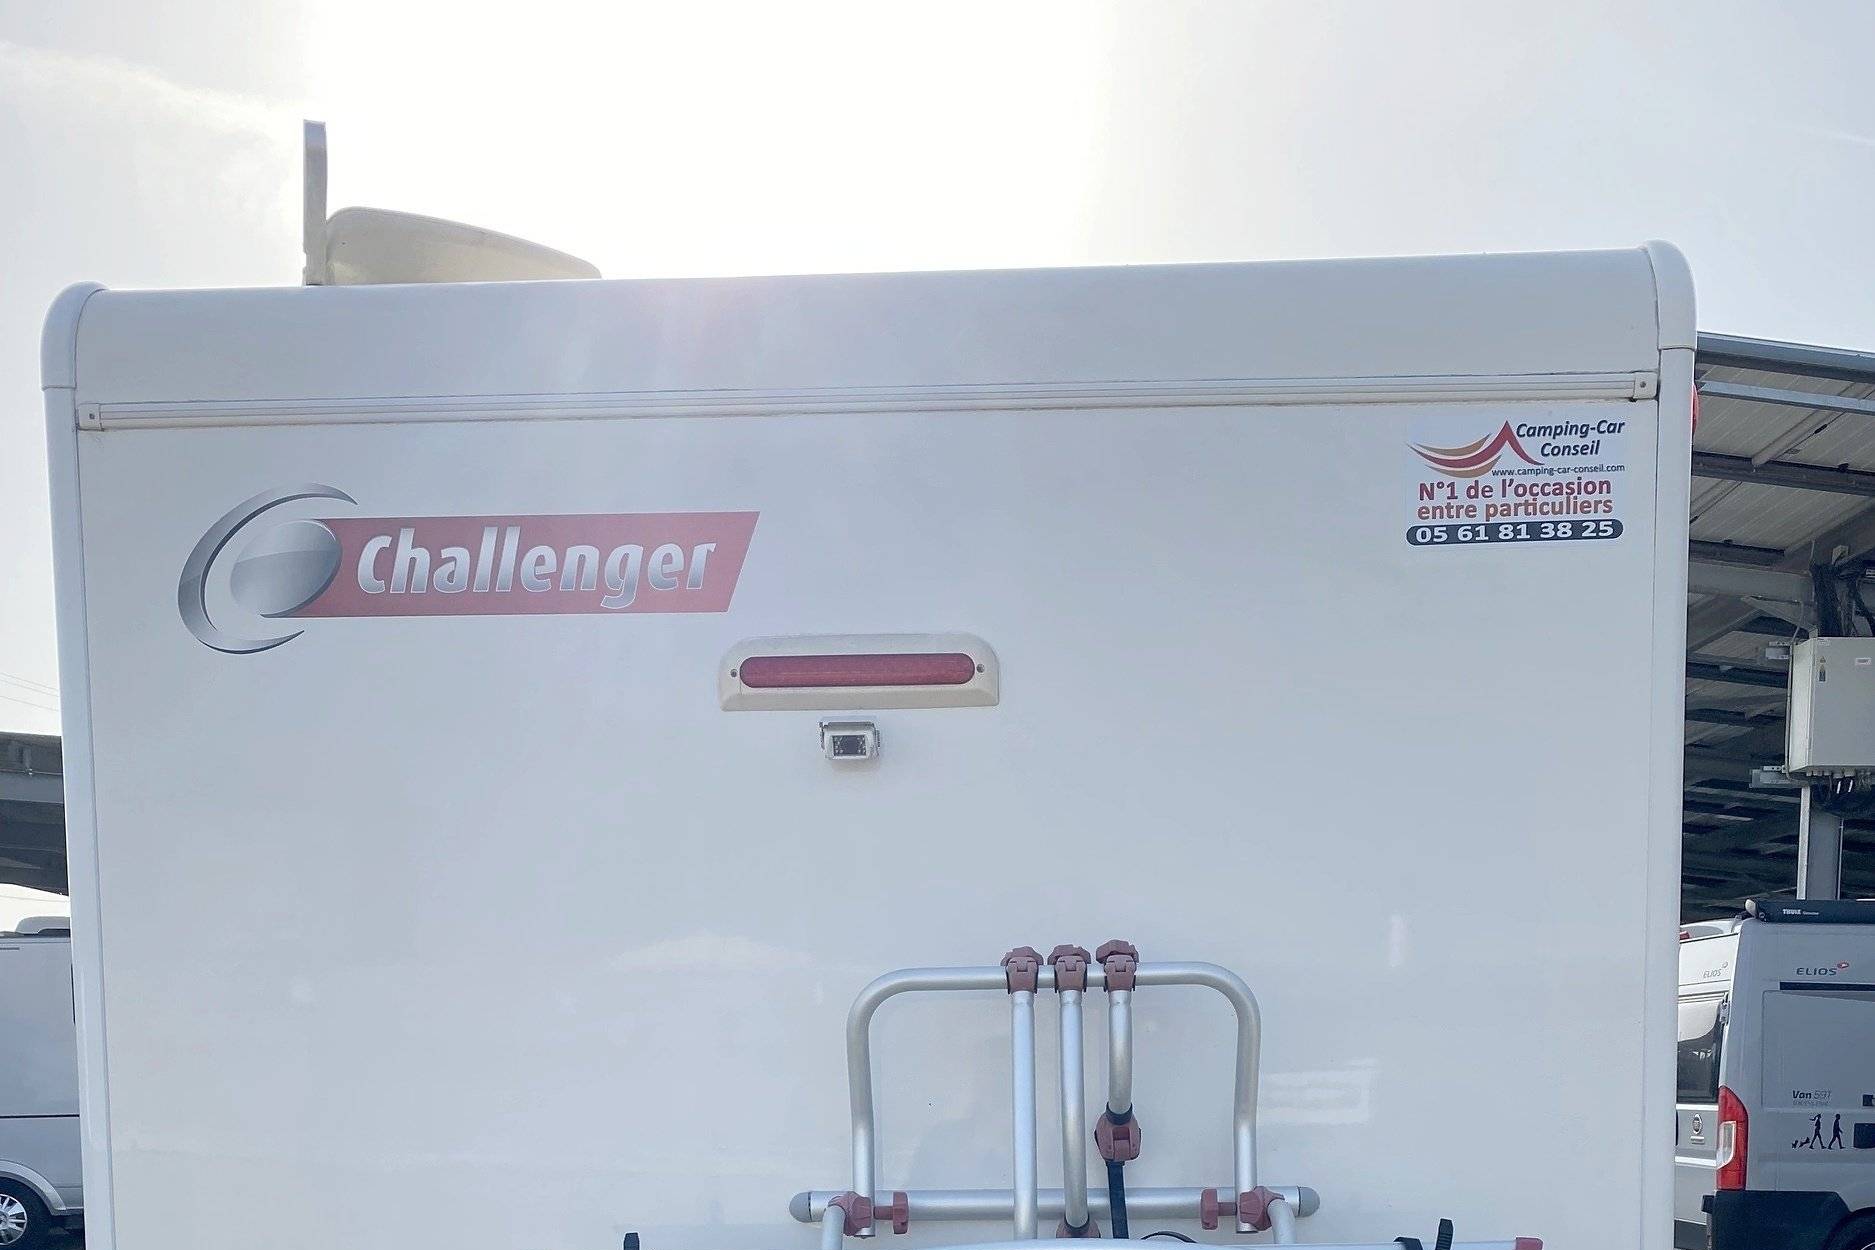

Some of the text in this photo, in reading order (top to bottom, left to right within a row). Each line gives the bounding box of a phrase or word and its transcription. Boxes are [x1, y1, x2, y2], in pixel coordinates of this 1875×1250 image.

[1515, 419, 1626, 440] Camping-Car
[1540, 440, 1601, 458] Conseil
[1491, 463, 1626, 478] www.camping-car-conseil.com
[1418, 481, 1459, 501] N°1
[1465, 479, 1494, 500] de
[1416, 495, 1614, 522] entre particuliers
[1415, 520, 1615, 544] 05 61 81 38 25
[356, 524, 718, 611] Challenger
[1796, 967, 1838, 976] ELIOS
[1792, 1089, 1812, 1099] Van
